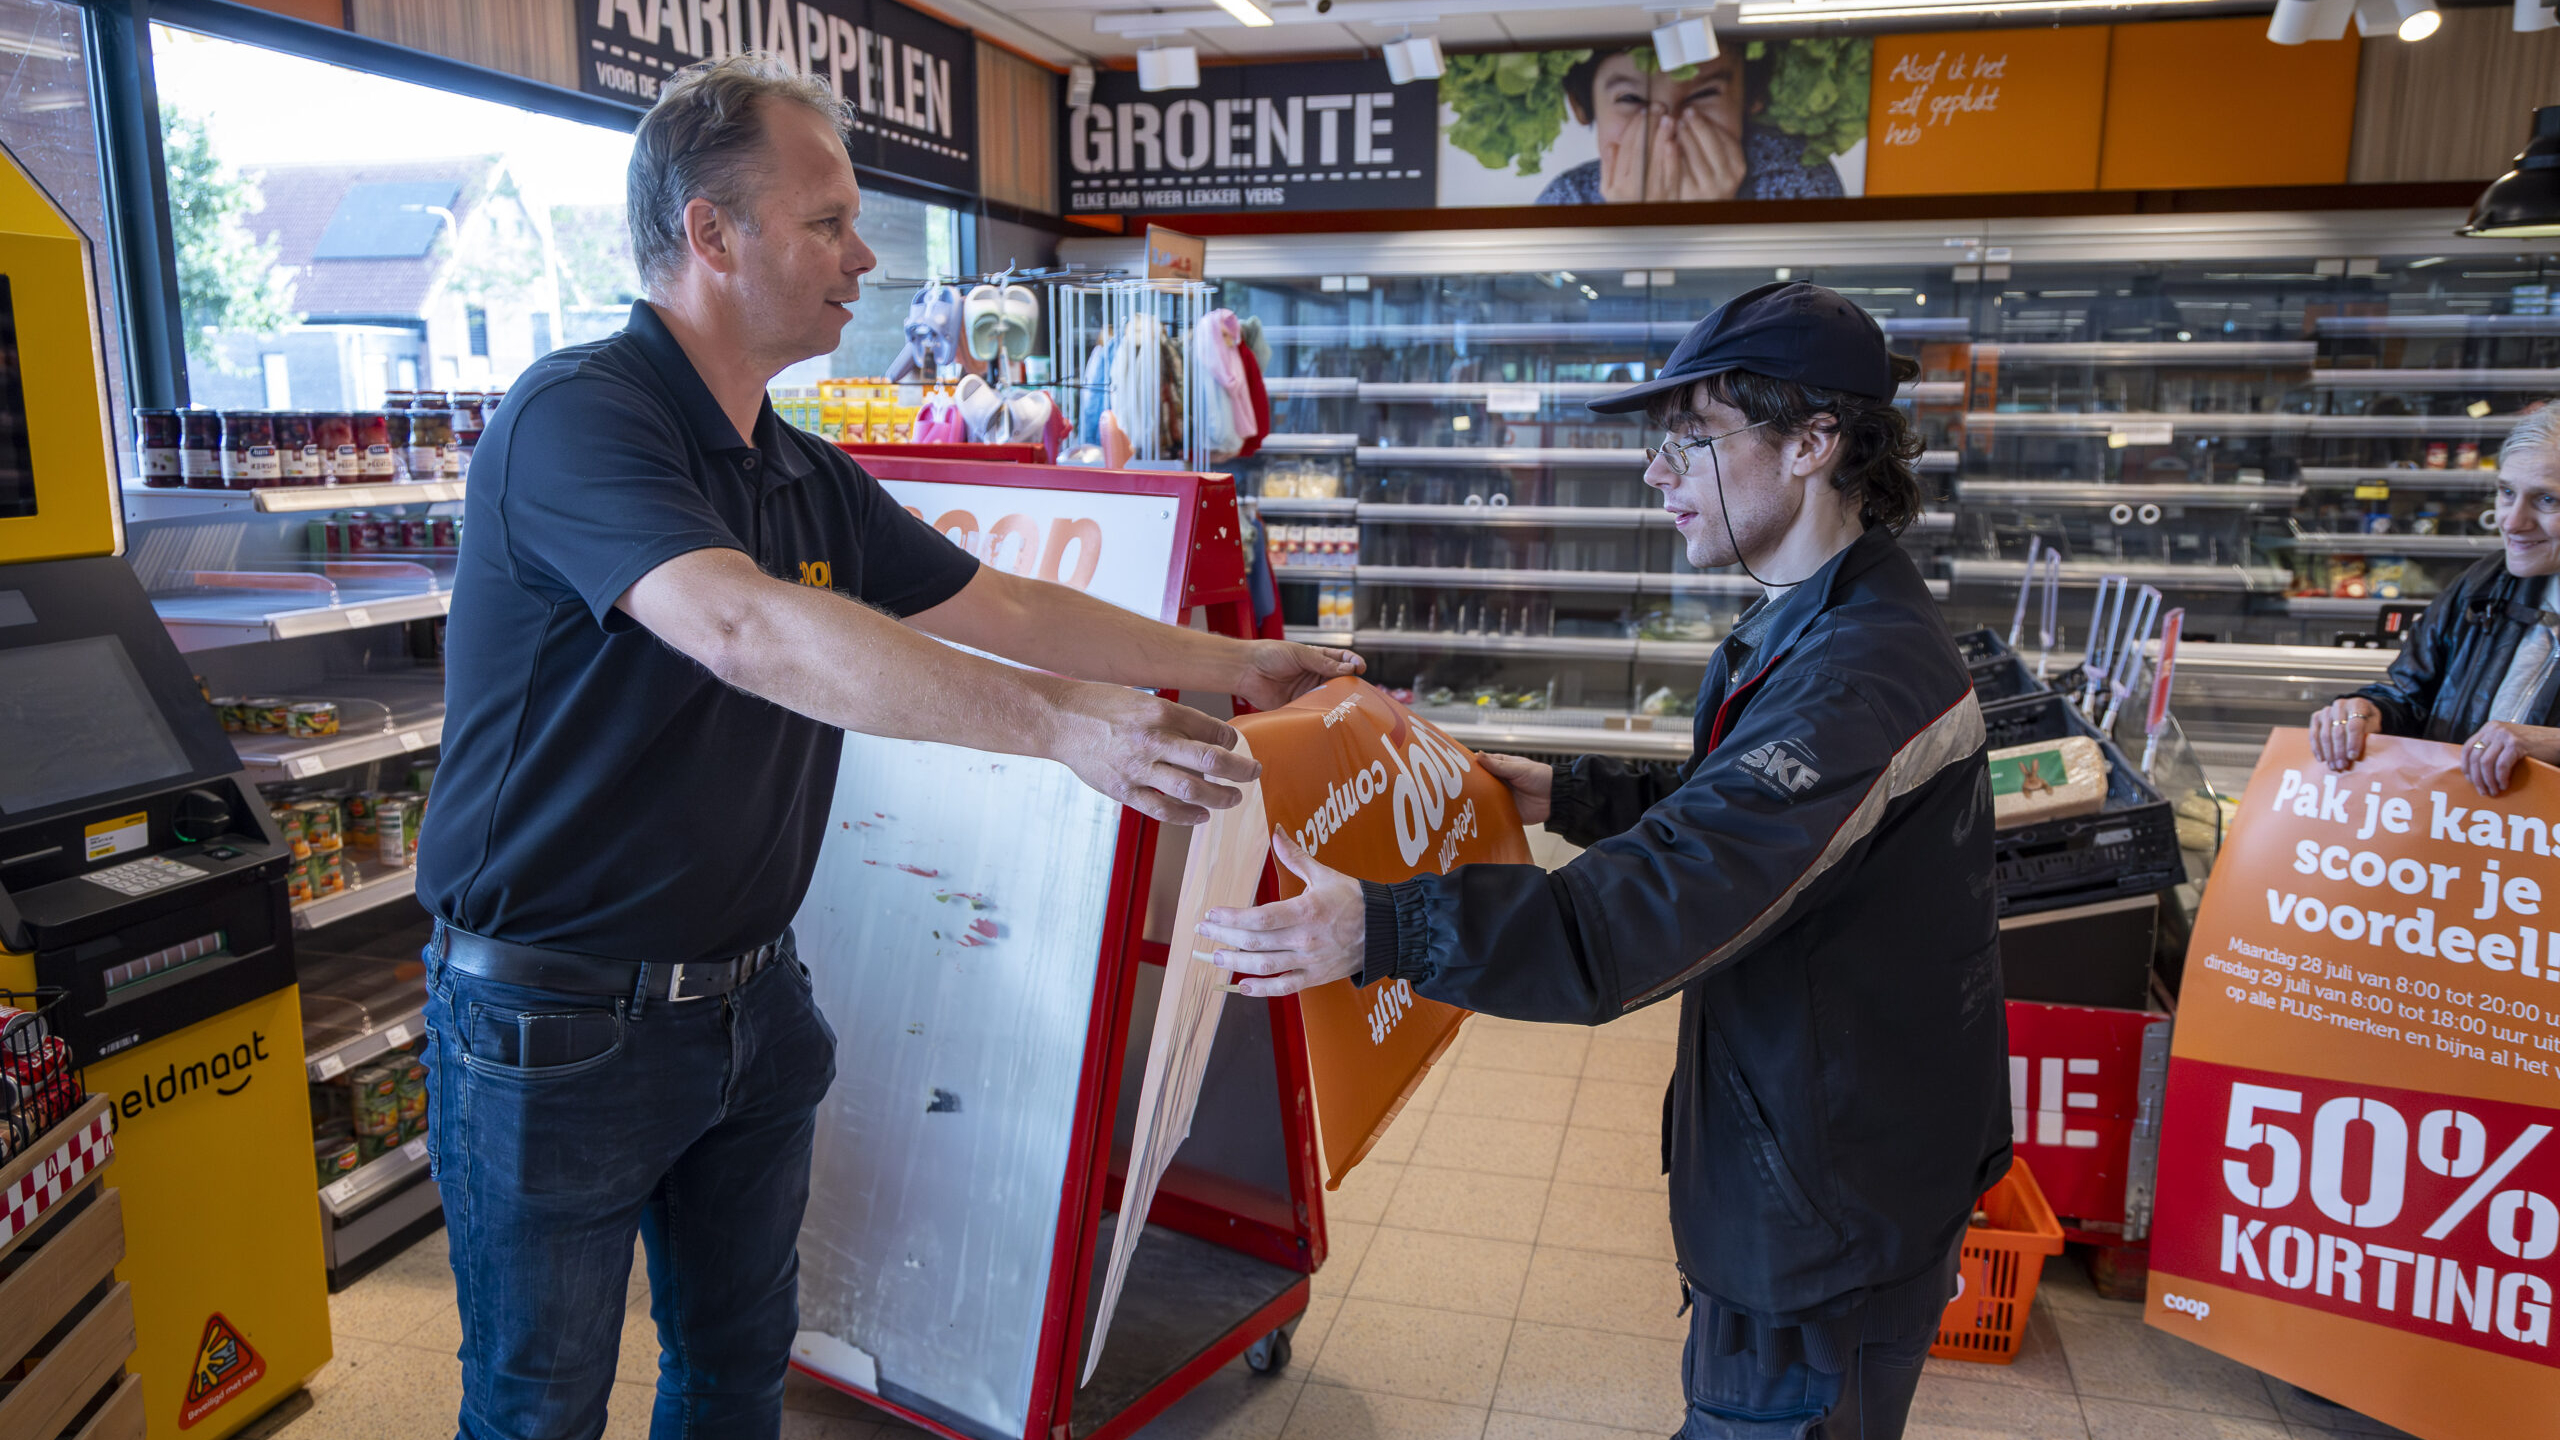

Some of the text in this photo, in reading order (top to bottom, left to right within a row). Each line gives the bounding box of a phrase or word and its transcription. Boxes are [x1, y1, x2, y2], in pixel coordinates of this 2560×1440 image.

[595, 60, 637, 95] VOOR
[638, 73, 658, 101] DE
[597, 0, 953, 139] ARDAPPELEN
[1888, 83, 1929, 118] zelf
[1947, 52, 1967, 79] ik
[1972, 54, 2008, 79] het
[1069, 92, 1394, 174] GROENTE
[1884, 121, 1922, 146] heb
[1072, 187, 1285, 209] ELKE DAG WEER LEKKER VERS
[1740, 742, 1821, 793] SKF
[2272, 769, 2352, 825] Pak
[2356, 782, 2413, 840] je
[2293, 839, 2542, 920] scoor je
[2266, 888, 2560, 983] voordeel!
[2204, 953, 2260, 985] dinsdag
[2261, 969, 2283, 987] 29
[2283, 975, 2310, 995] juli
[2314, 985, 2346, 1004] van
[2350, 991, 2393, 1014] 8:00
[2398, 1003, 2425, 1022] tot
[2430, 1008, 2486, 1035] 18:00
[2491, 1025, 2529, 1044] uur
[2227, 936, 2297, 971] Maandag
[2300, 955, 2322, 974] 28
[2324, 961, 2353, 981] juli
[2356, 970, 2390, 990] van
[2395, 976, 2440, 1000] 8:00
[2446, 988, 2474, 1008] tot
[2479, 994, 2540, 1022] 20:00
[2226, 986, 2247, 1004] op
[2248, 990, 2276, 1010] alle
[2280, 997, 2401, 1041] PLUS-merken
[2405, 1031, 2431, 1048] en
[2436, 1034, 2486, 1061] bijna
[2490, 1050, 2509, 1067] al
[2514, 1053, 2549, 1077] het
[2222, 1082, 2560, 1260] 50%
[2163, 1293, 2211, 1321] coop
[2220, 1213, 2553, 1347] KORTING
[187, 1368, 258, 1421] Beveiligd met inkt
